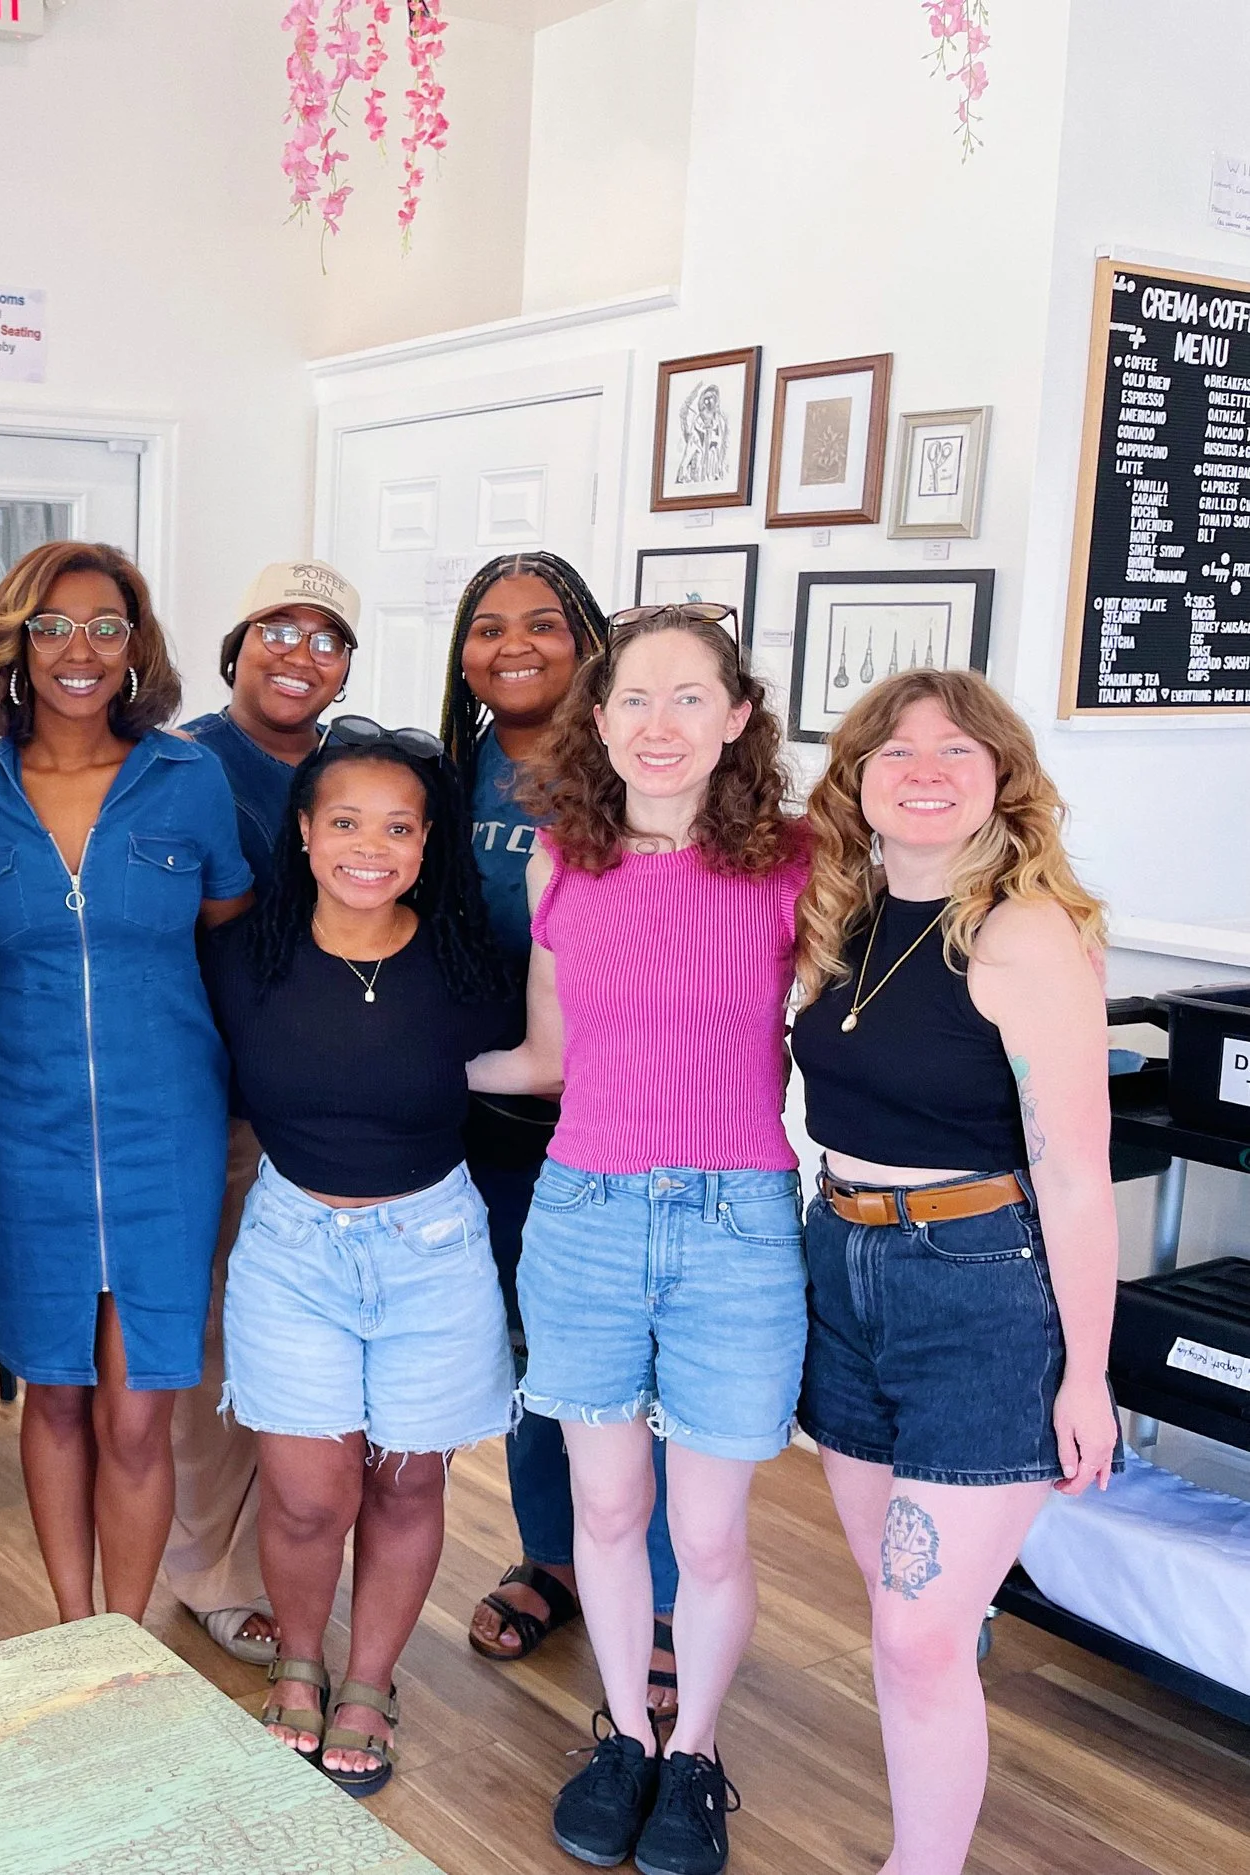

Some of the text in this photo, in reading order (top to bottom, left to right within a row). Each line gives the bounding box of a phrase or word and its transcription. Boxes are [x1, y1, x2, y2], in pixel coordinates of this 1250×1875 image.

[1141, 286, 1250, 333] CREMA COFF
[0, 325, 42, 341] Seating
[1174, 331, 1230, 368] MENU
[1124, 354, 1158, 372] COFFEE
[1122, 371, 1171, 391] COLD BREW
[1120, 389, 1165, 407] ESPRESSO
[1119, 407, 1167, 425] AMERICANO
[1207, 407, 1246, 425] OATMEAL
[1117, 424, 1155, 441] CORTADO
[1204, 423, 1244, 440] AVOCADO
[1116, 441, 1168, 460] CAPPUCCINO
[1203, 441, 1238, 457] BISCUITS
[1115, 459, 1144, 475] LATTE
[1202, 462, 1238, 478] CHICKEN
[1133, 479, 1168, 493] VANILLA
[1200, 480, 1240, 495] CAPRESE
[1131, 492, 1169, 507] CARAMEL
[1199, 496, 1237, 511] GRILLED
[1130, 505, 1159, 518] MOCHA
[1130, 517, 1174, 532] LAVENDER
[1198, 513, 1232, 528] TOMATO
[1129, 531, 1157, 544] HONEY
[1197, 528, 1216, 543] BLT
[1128, 543, 1185, 558] SIMPLE SYRUP
[1127, 556, 1154, 569] BROWN
[289, 564, 347, 593] COFFEE
[1125, 568, 1188, 583] SUGAR CINNAMON
[302, 580, 334, 597] RUN
[1103, 597, 1168, 612] HOT CHOCOLATE
[1192, 595, 1215, 609] SIDES
[1102, 610, 1141, 624] STEAMER
[1191, 609, 1216, 621] BACON
[1101, 623, 1122, 636] CHAI
[1191, 621, 1220, 633] TURKEY
[1100, 635, 1135, 649] MATCHA
[1190, 633, 1204, 645] EGG
[1100, 648, 1117, 661] TEA
[1189, 645, 1211, 657] TOAST
[1099, 661, 1111, 674] OJ
[1188, 655, 1249, 670] AVOCADO SMASH
[1098, 673, 1160, 687] SPARKLING TEA
[1187, 669, 1210, 682] CHIPS
[1098, 688, 1158, 703] ITALIAN SODA
[1171, 689, 1212, 702] EVERYTHING
[1214, 687, 1235, 702] MADE
